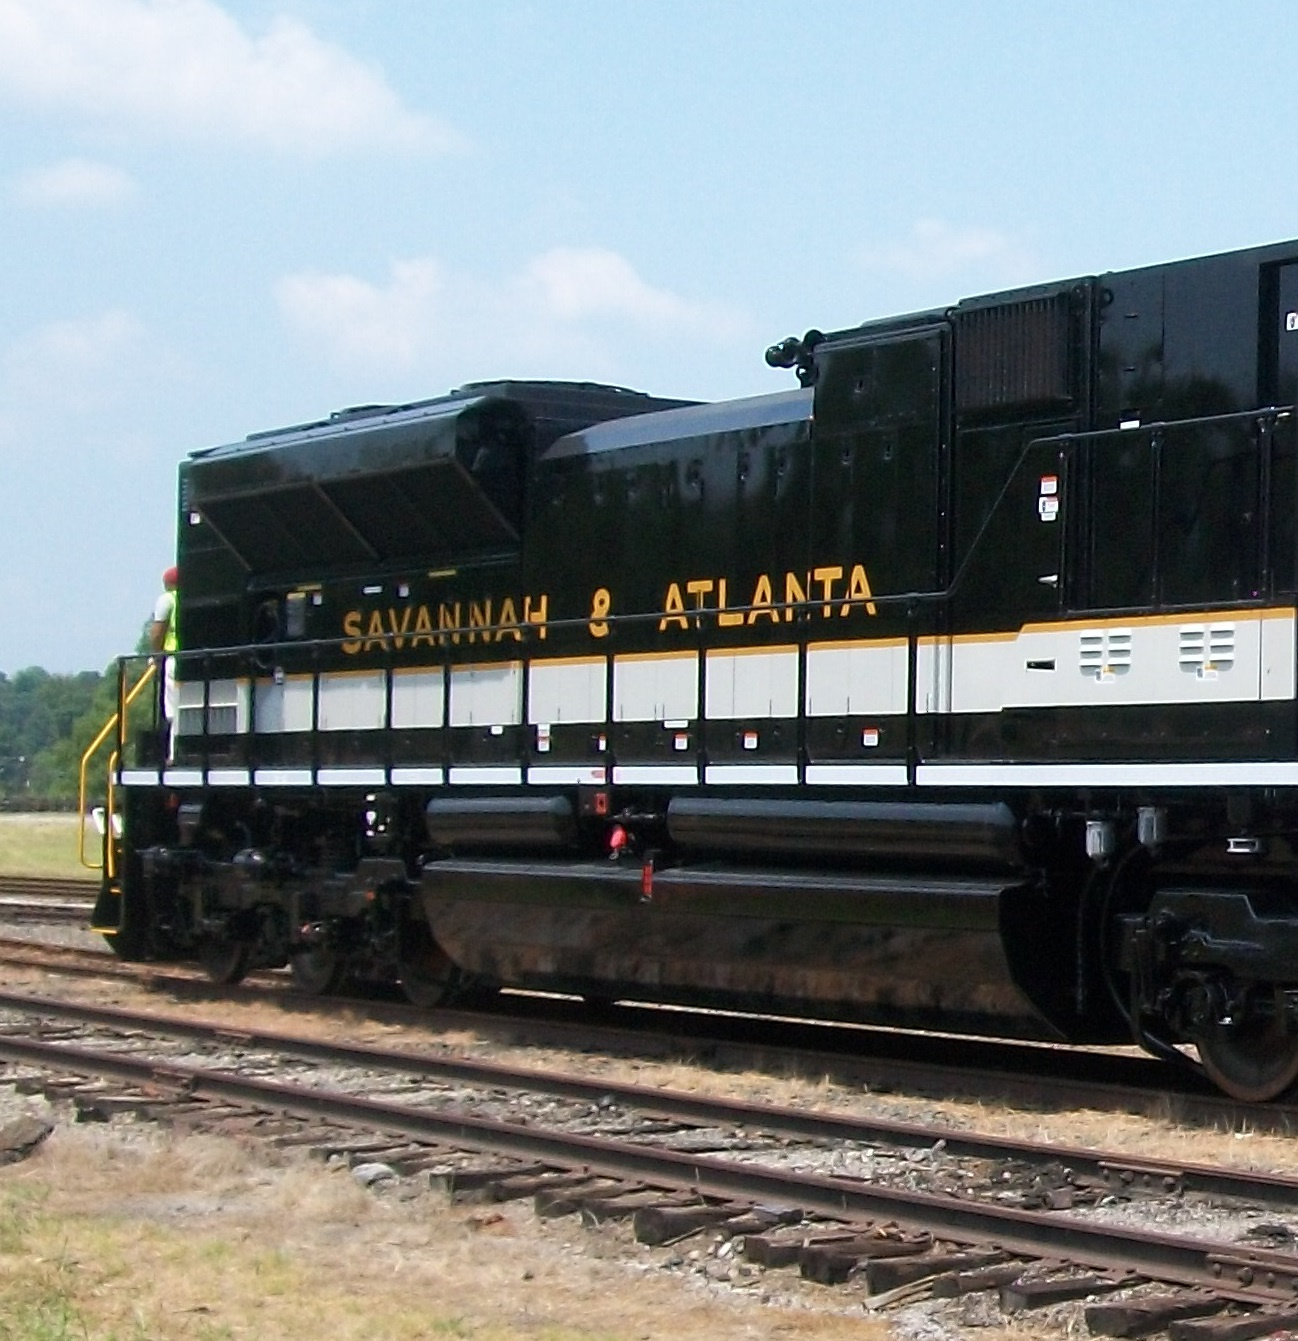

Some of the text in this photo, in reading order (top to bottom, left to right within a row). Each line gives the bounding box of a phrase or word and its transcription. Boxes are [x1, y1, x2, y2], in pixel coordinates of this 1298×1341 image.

[341, 563, 878, 655] SAVANNAH & ATLANTA
